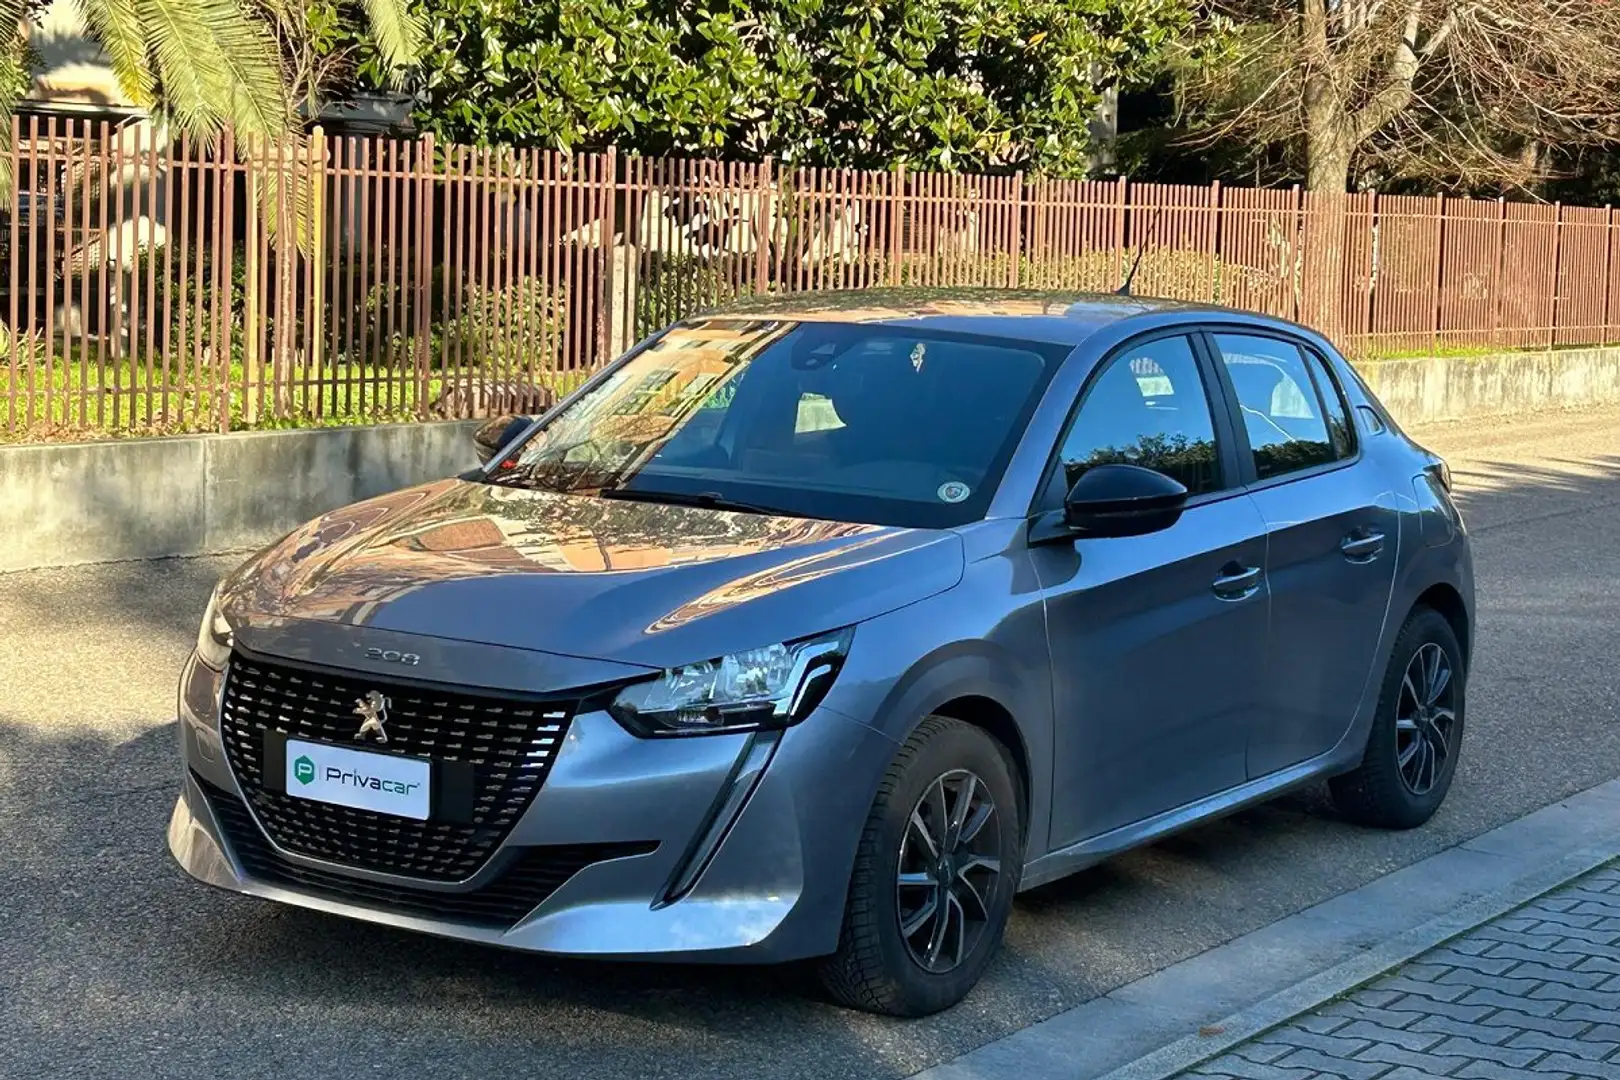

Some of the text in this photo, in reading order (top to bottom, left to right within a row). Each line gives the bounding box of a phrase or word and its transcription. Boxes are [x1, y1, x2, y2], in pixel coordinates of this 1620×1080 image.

[365, 647, 420, 666] 208
[297, 764, 419, 796] P Privacar
